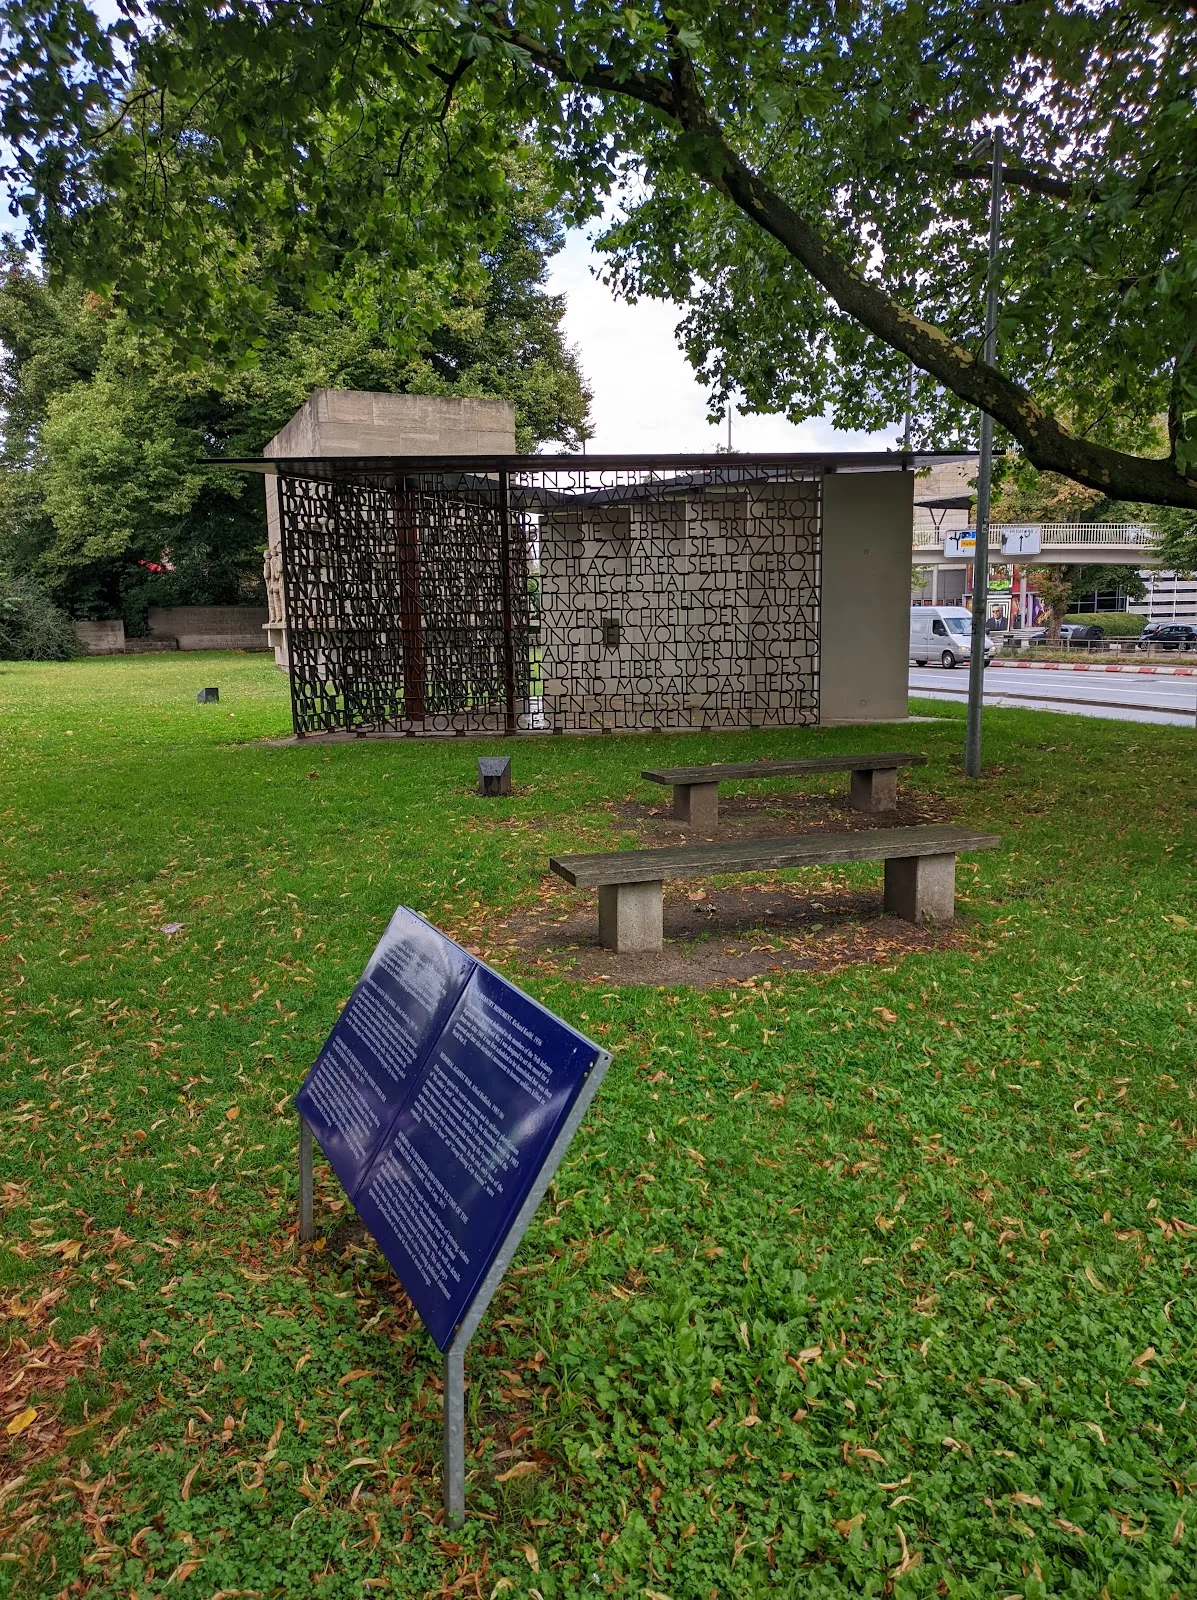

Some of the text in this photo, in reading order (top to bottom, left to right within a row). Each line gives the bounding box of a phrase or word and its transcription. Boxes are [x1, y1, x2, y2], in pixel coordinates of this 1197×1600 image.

[568, 470, 590, 488] SIE
[600, 467, 666, 488] GEBEN
[675, 467, 694, 486] ES
[690, 501, 743, 520] SEELE
[577, 521, 603, 541] SIE
[612, 520, 679, 540] GEBEN
[688, 519, 710, 538] ES
[595, 538, 682, 558] ZWANG
[690, 536, 717, 556] SIE
[725, 535, 787, 554] DAZU
[625, 555, 681, 575] IHRER
[687, 554, 742, 573] SEELE
[568, 574, 645, 593] KRIEGES
[653, 572, 689, 592] HAT
[697, 571, 727, 590] ZU
[736, 570, 790, 589] EINER
[594, 591, 634, 610] DER
[642, 588, 750, 610] STRENGEN
[703, 605, 744, 625] DER
[590, 625, 630, 645] DER
[638, 622, 820, 645] VOLKSGENOSSEN
[588, 643, 623, 662] UM
[630, 642, 678, 661] NUN
[611, 659, 667, 678] LEIBER
[674, 658, 721, 677] SÜSS
[766, 656, 801, 675] DES
[560, 677, 607, 696] SIND
[615, 675, 698, 696] MOSAIK
[706, 674, 746, 694] DAS
[594, 692, 635, 713] SICH
[644, 691, 691, 711] RISSE
[700, 690, 771, 711] ZIEHEN
[779, 688, 820, 709] DIES
[516, 712, 605, 730] GESEHEN
[614, 709, 693, 729] LÜCKEN
[702, 708, 752, 727] MAN
[763, 706, 820, 726] MUSS
